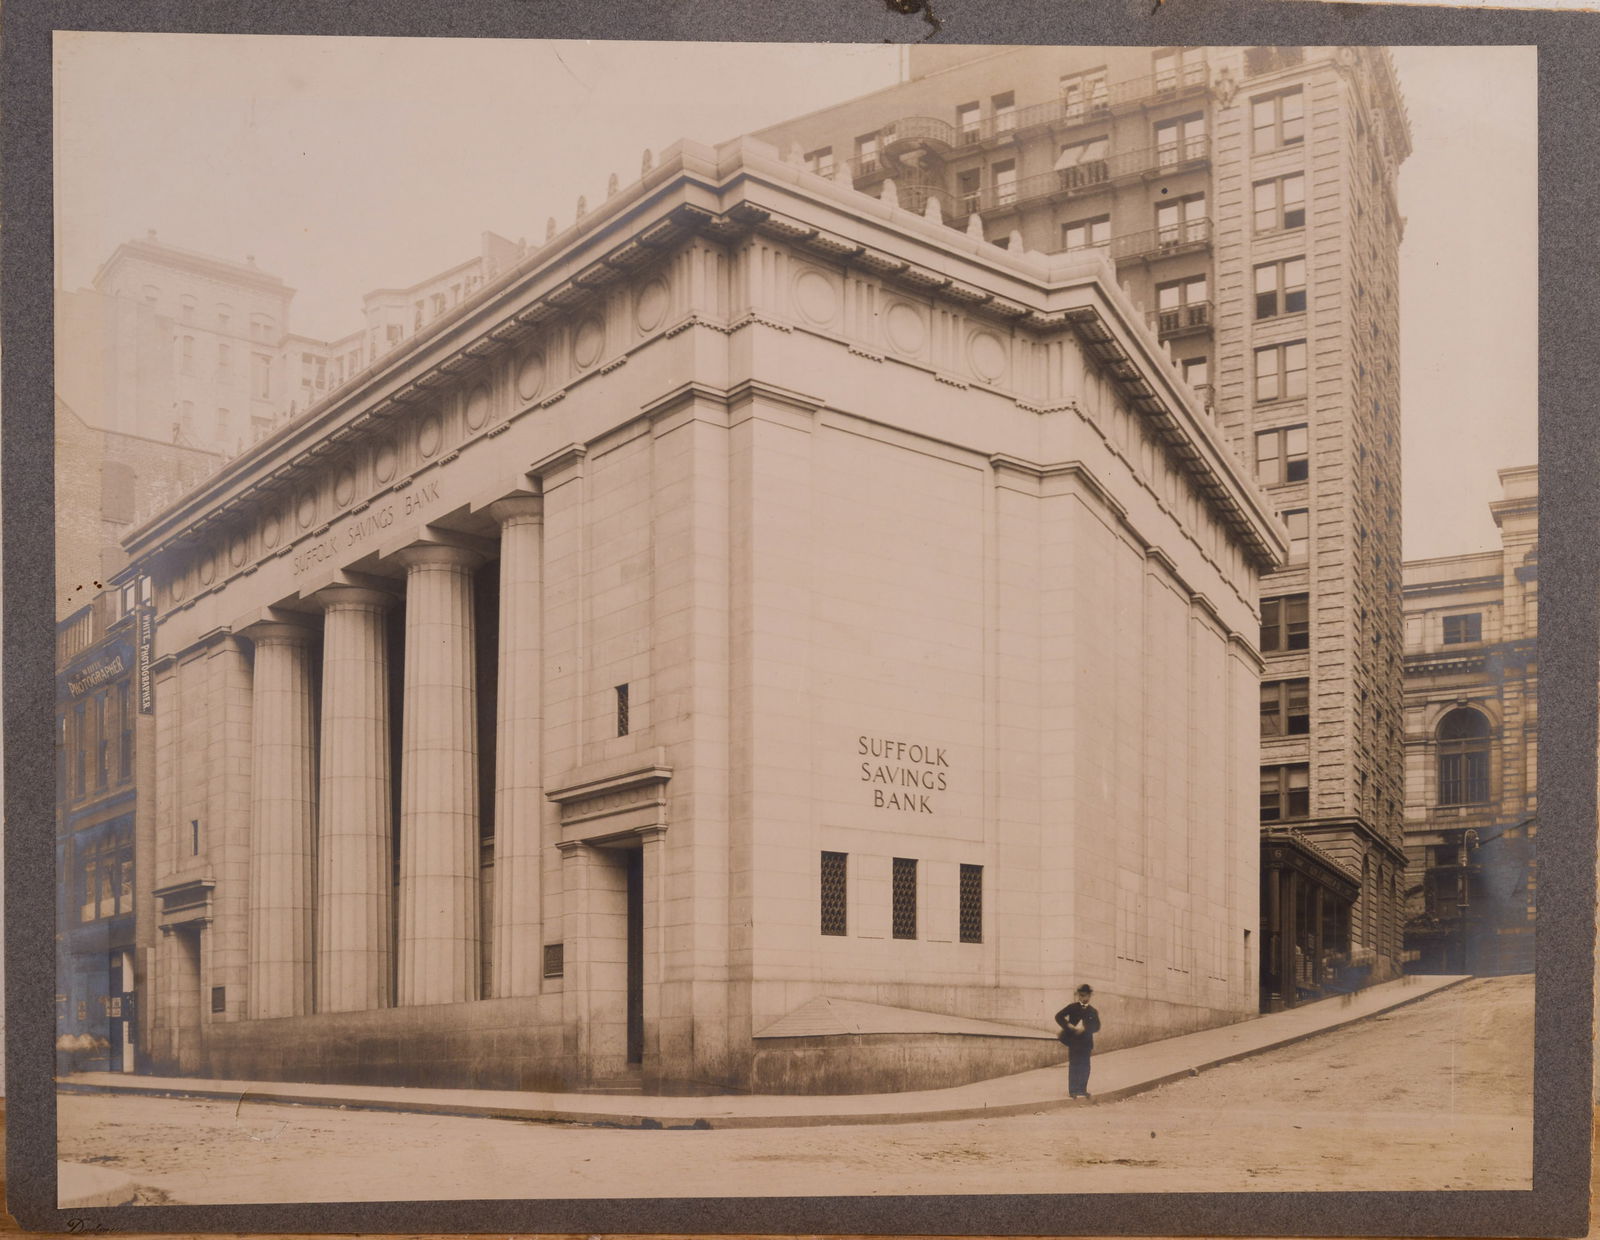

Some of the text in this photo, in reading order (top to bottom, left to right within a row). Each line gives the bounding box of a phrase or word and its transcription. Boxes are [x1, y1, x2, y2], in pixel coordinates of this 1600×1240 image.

[293, 480, 440, 576] SUFFOLK SAVINGS BANK
[67, 655, 125, 698] PHOTOGRAPHER
[858, 735, 949, 767] SUFFOLK
[861, 762, 947, 791] SAVINGS
[874, 789, 933, 814] BANK
